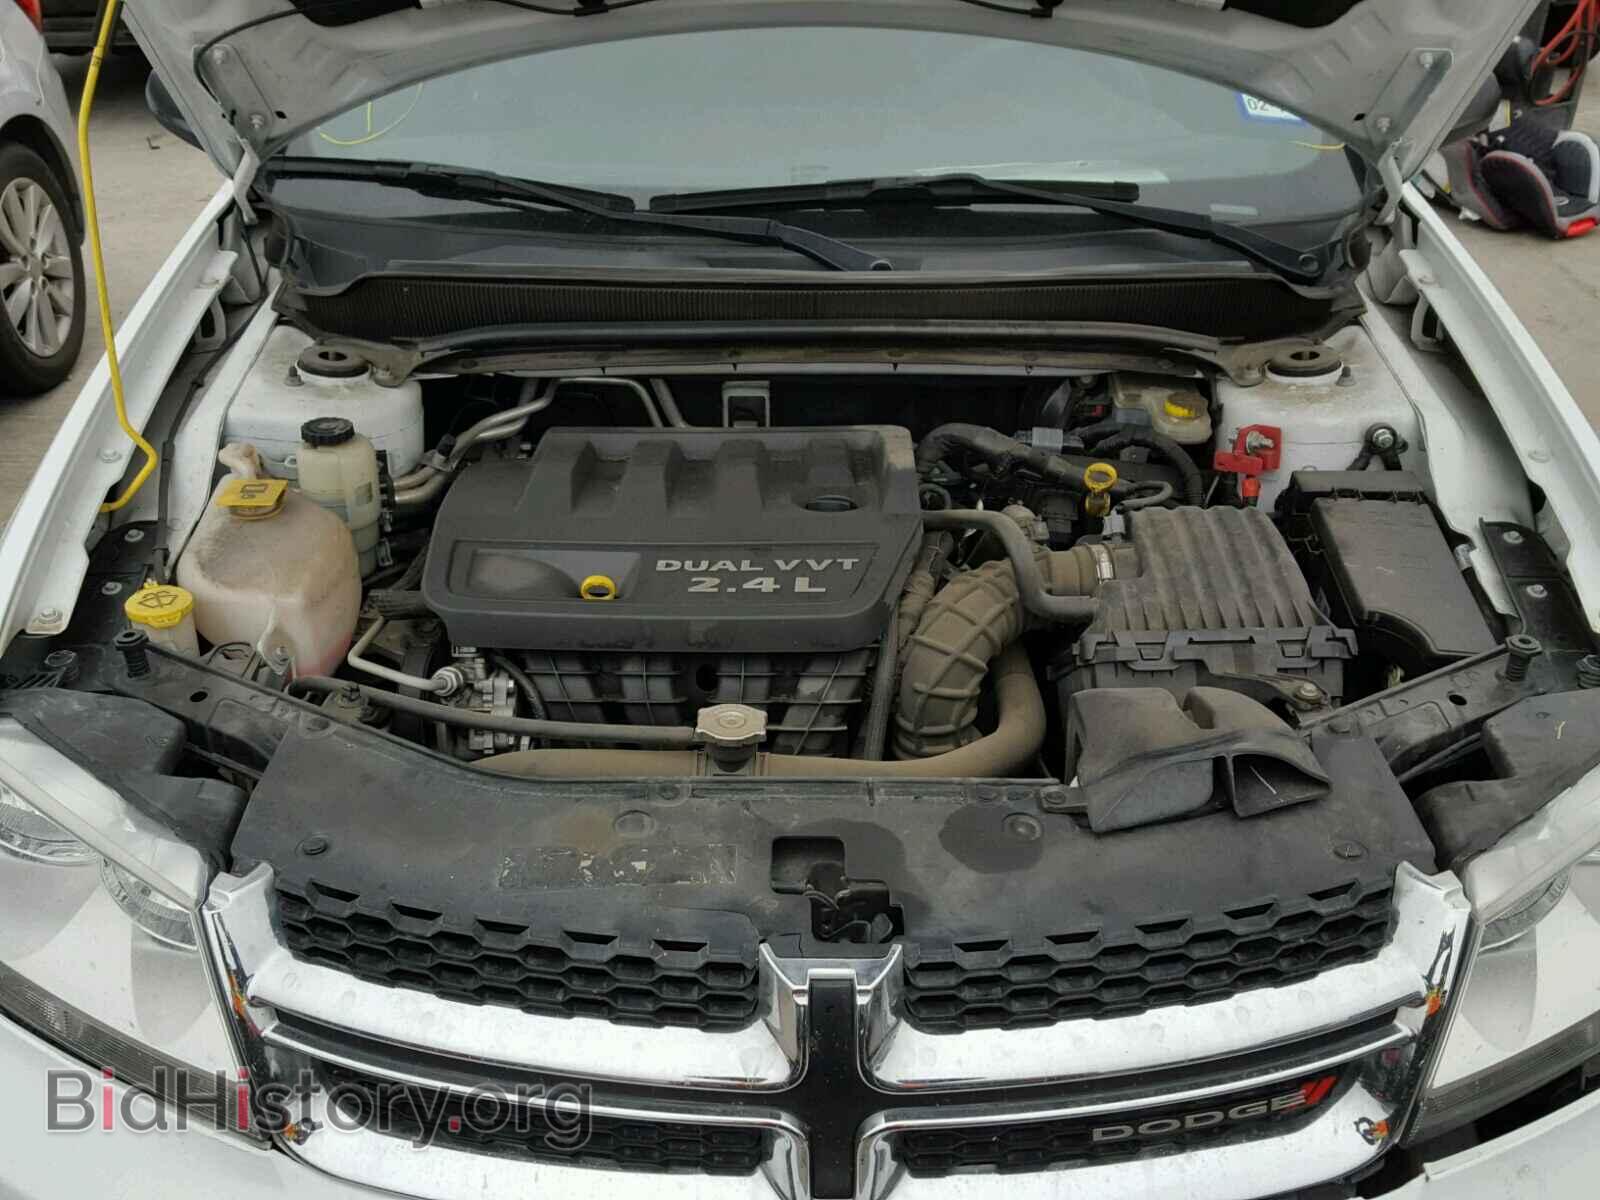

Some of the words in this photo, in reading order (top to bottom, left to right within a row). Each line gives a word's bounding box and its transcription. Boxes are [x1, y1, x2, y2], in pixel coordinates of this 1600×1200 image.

[656, 560, 763, 571] DUAL
[774, 559, 859, 570] VVT
[688, 577, 780, 592] 2.4
[1092, 1089, 1306, 1141] DODGE
